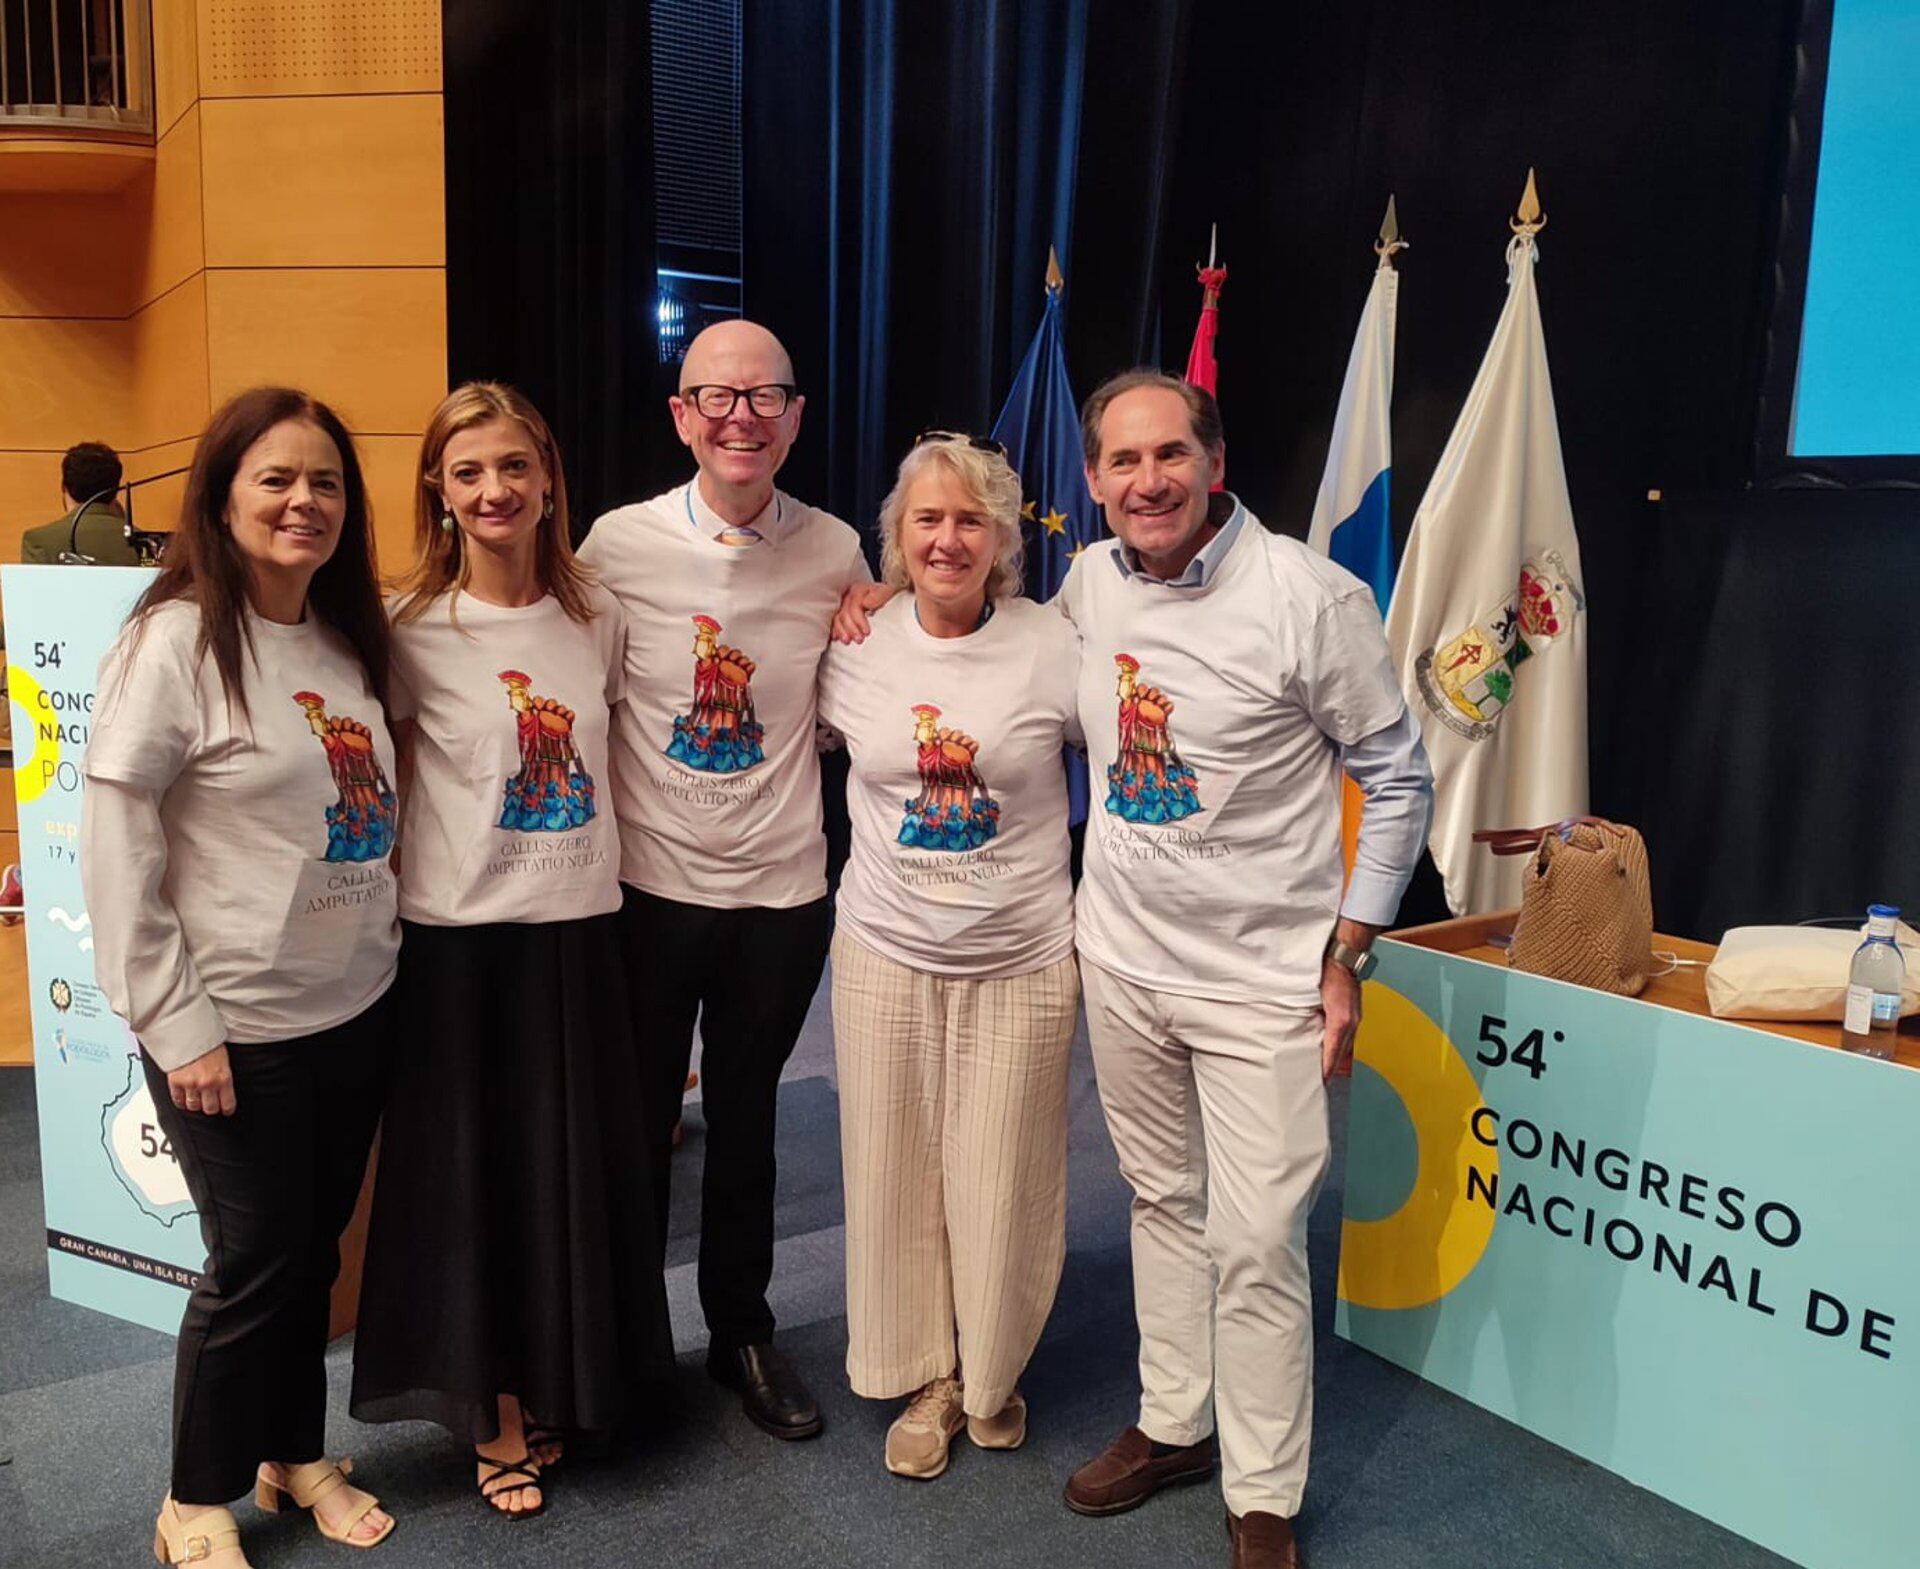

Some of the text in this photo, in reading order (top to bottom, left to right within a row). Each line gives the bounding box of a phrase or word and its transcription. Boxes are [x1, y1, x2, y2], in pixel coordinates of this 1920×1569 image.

[40, 722, 88, 745] NACI
[42, 760, 86, 792] PO
[501, 835, 591, 857] CALLUS ZERO
[1154, 831, 1202, 845] ZERO
[49, 845, 62, 859] 17
[486, 851, 606, 876] AMPUTATIO NULLA
[956, 849, 995, 866] ZERO
[969, 861, 1014, 880] NULLA
[141, 1122, 177, 1164] 54
[1471, 1107, 1801, 1248] CONGRESO
[59, 1236, 85, 1253] GRAN
[132, 1259, 152, 1272] UNA
[155, 1266, 173, 1280] ISLA
[176, 1272, 188, 1286] DE
[1466, 1166, 1896, 1359] NACIONAL DE
